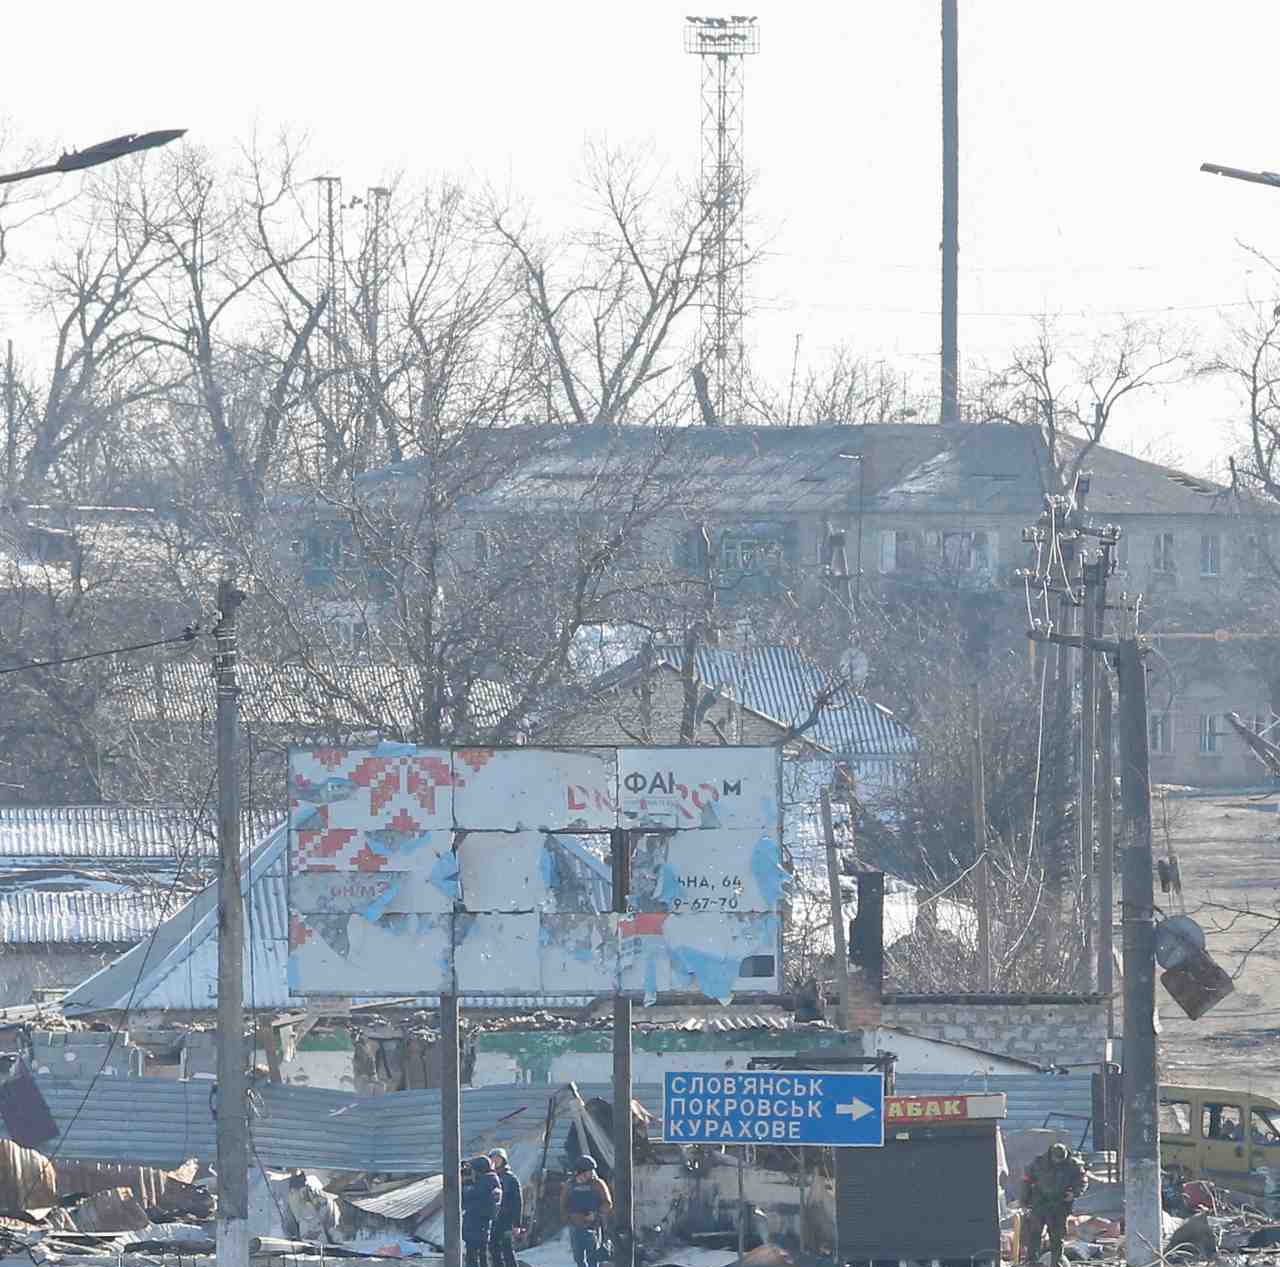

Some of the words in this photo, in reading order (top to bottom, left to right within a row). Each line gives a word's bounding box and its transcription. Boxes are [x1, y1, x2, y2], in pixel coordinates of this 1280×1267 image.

[671, 1076, 824, 1097] СЛОВ'ЯНСЬК
[670, 1098, 823, 1118] ПОКРОВСЬК
[887, 1101, 961, 1117] АБАК
[670, 1120, 801, 1139] КУРАХОВЕ
